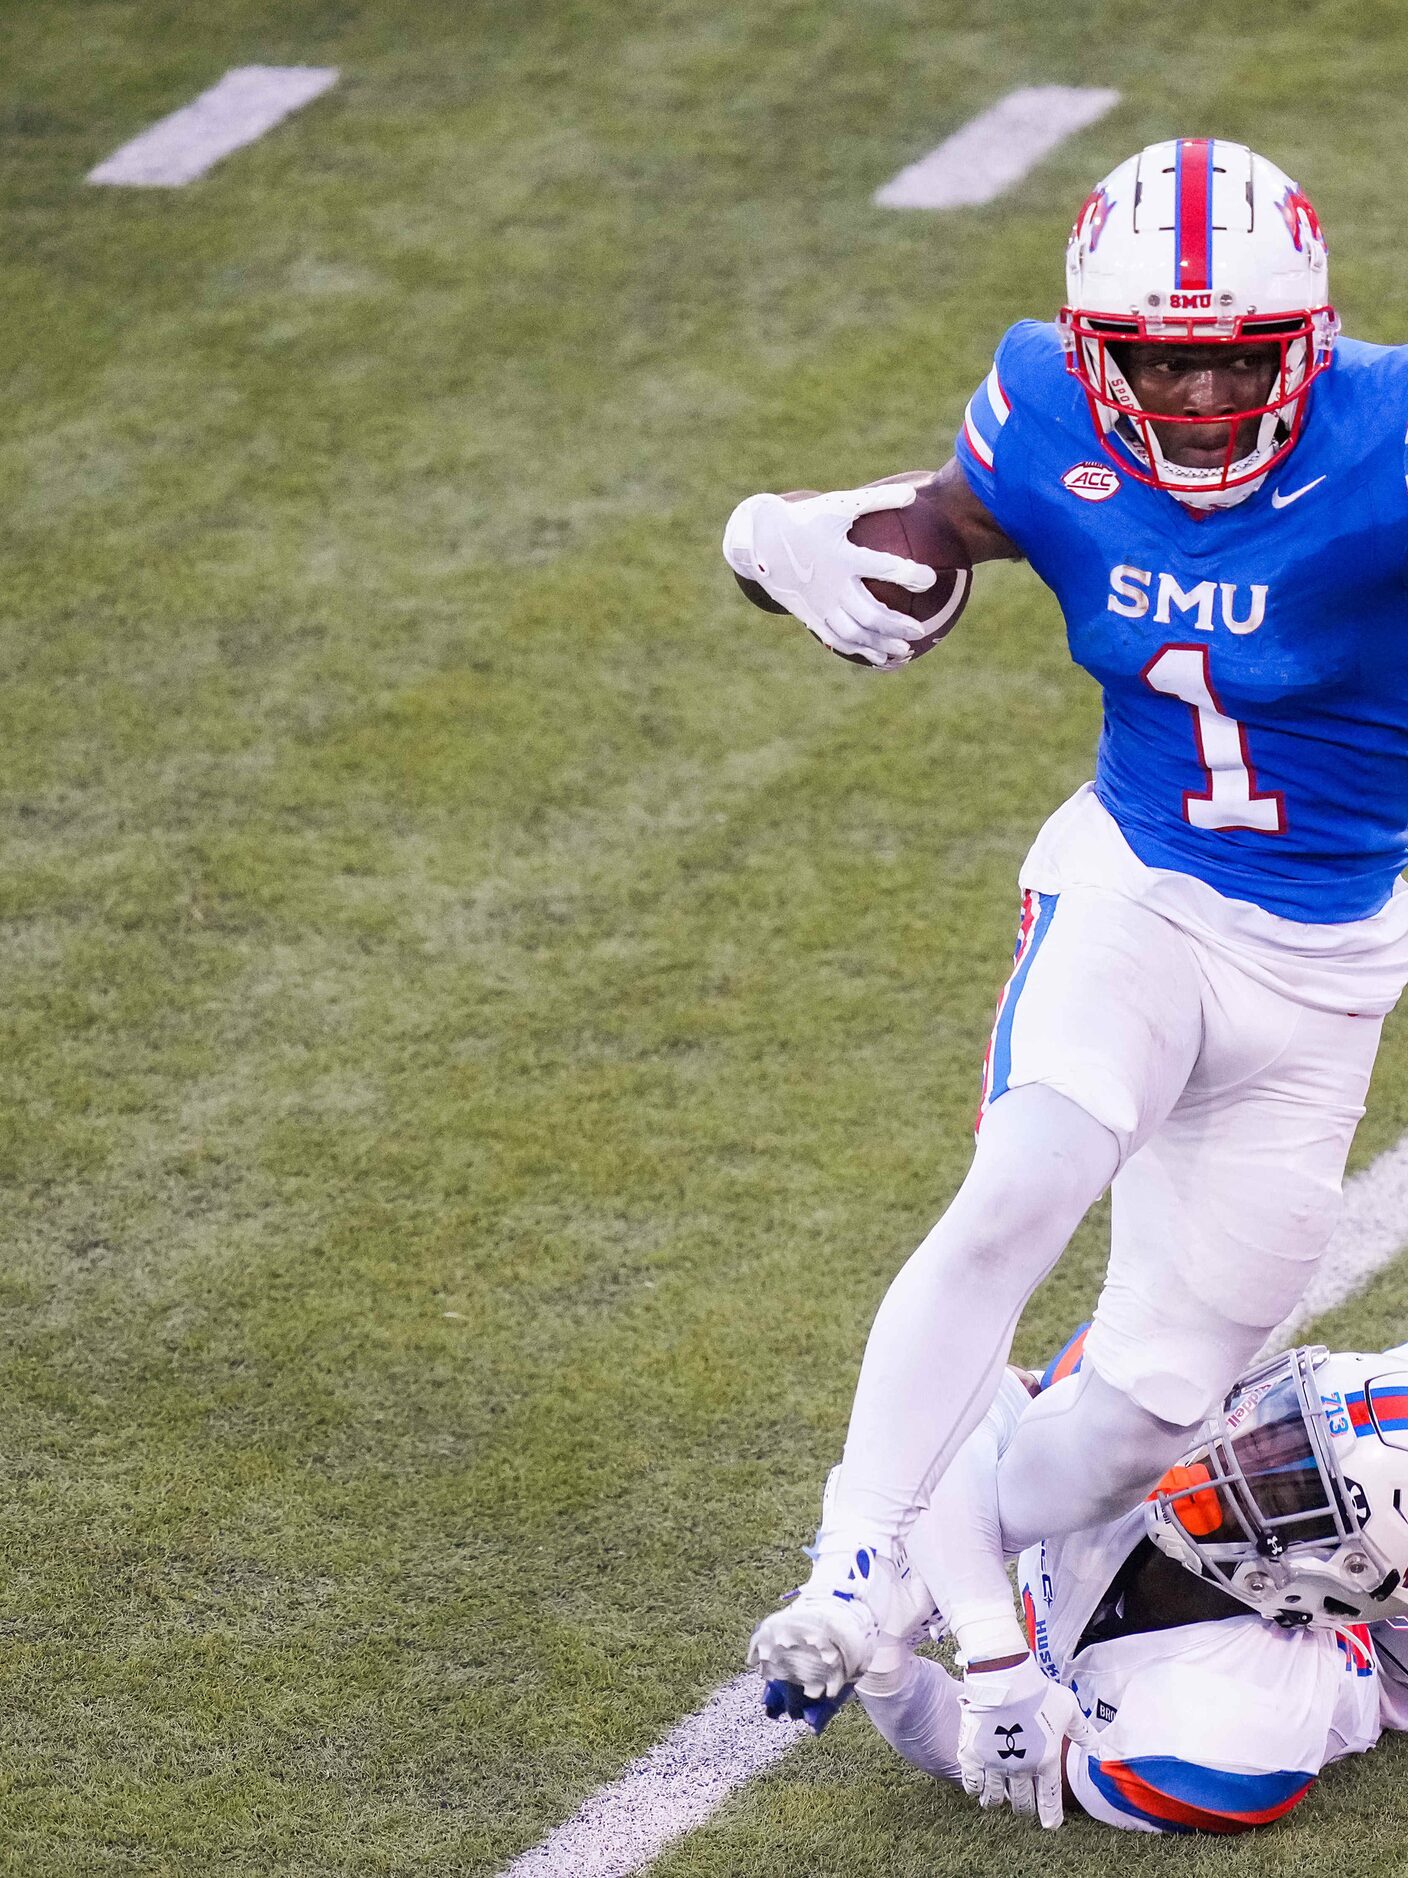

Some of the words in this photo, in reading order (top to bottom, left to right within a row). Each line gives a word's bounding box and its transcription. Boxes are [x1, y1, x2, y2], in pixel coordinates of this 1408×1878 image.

[1169, 294, 1212, 309] SMU
[1071, 471, 1114, 487] ACC
[1106, 564, 1269, 635] SMU
[1138, 642, 1289, 835] 1
[1320, 1391, 1349, 1438] 713
